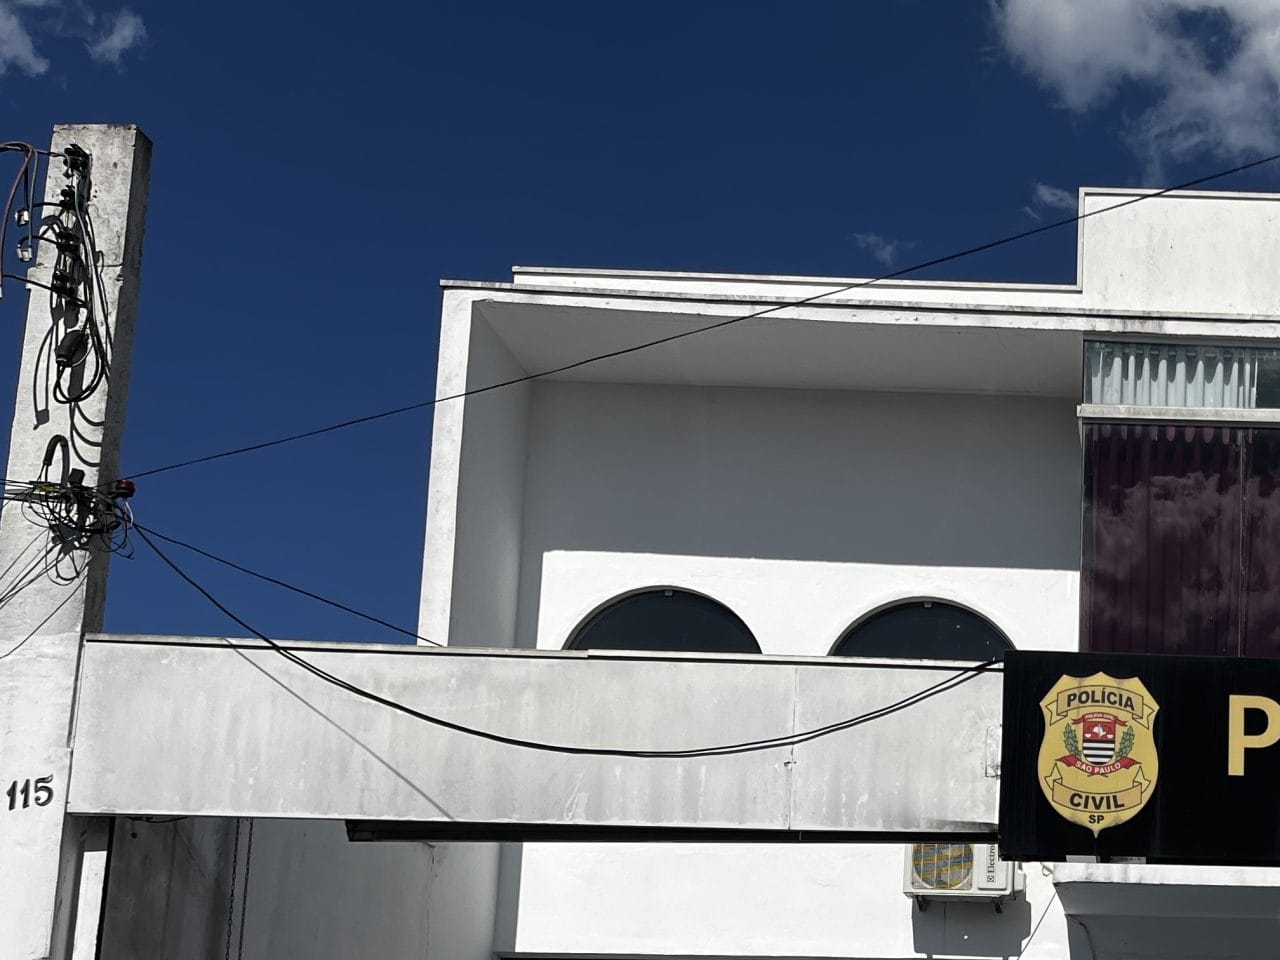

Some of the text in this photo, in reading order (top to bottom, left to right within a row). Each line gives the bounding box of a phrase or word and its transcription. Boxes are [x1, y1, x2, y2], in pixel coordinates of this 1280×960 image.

[1067, 688, 1135, 711] POLÍCIA
[1094, 761, 1121, 774] PAULO
[6, 775, 54, 810] 115
[1069, 793, 1125, 810] CIVIL
[1088, 814, 1104, 824] SP
[987, 845, 995, 873] Electro
